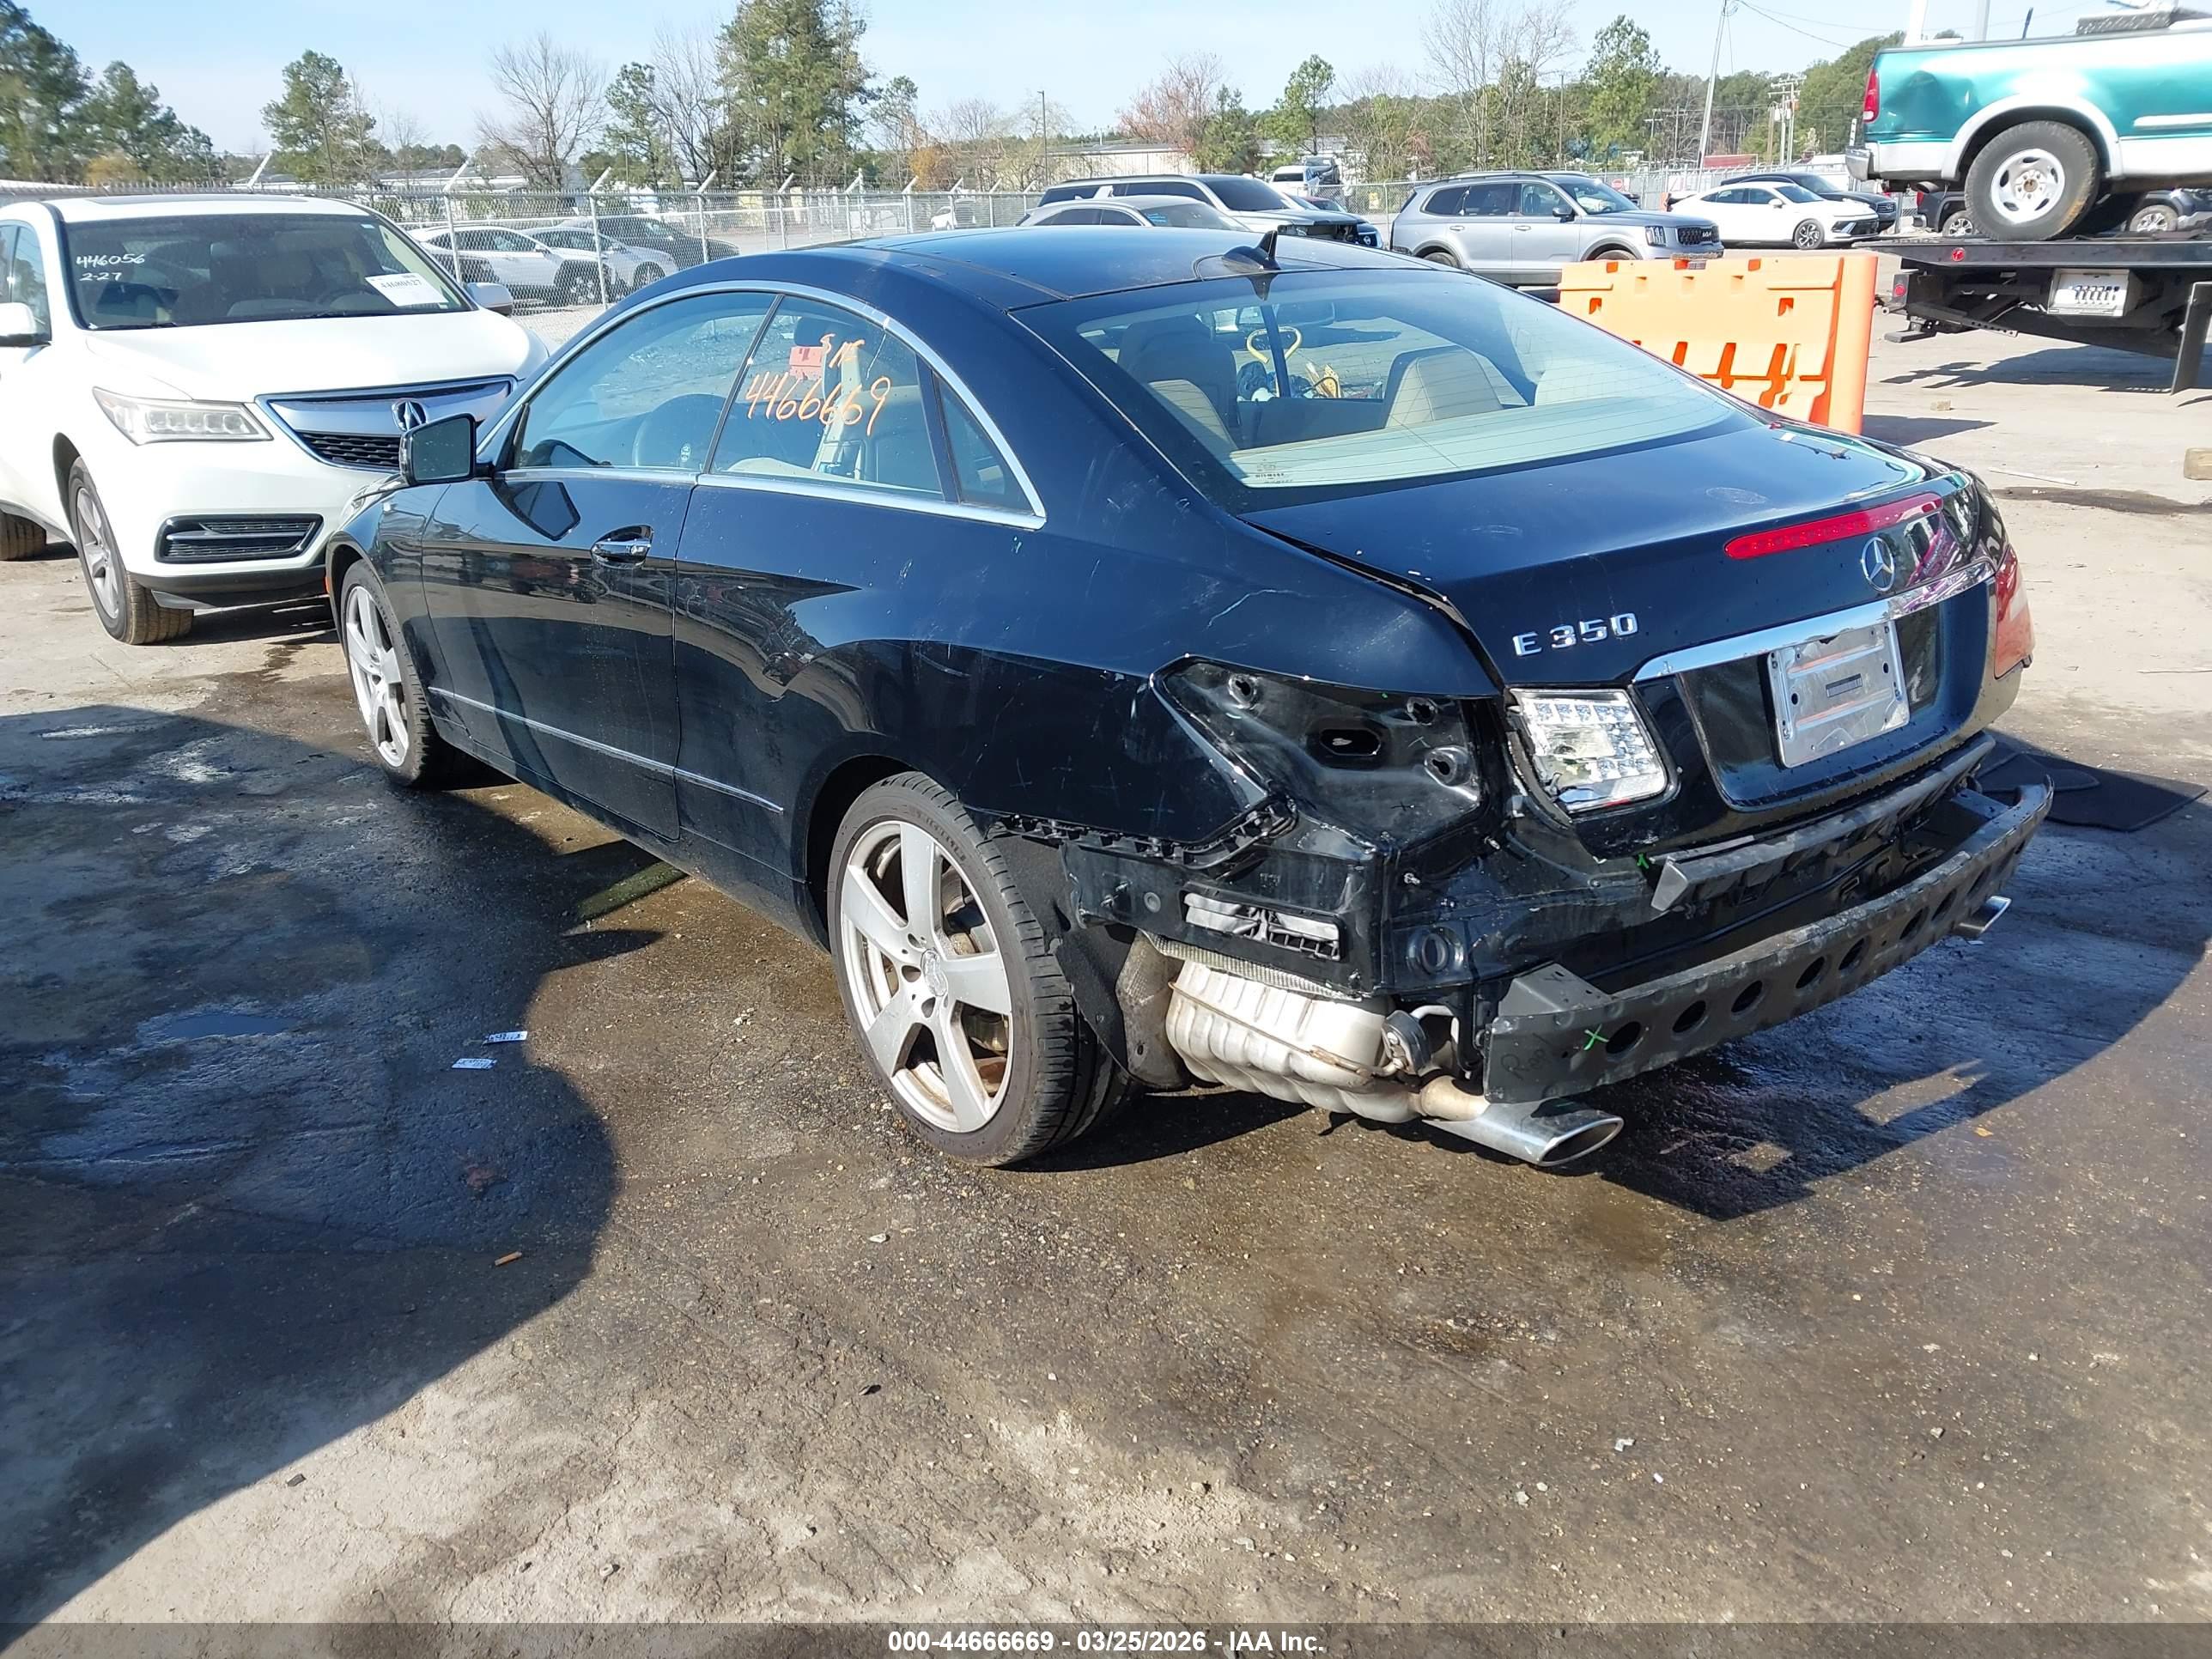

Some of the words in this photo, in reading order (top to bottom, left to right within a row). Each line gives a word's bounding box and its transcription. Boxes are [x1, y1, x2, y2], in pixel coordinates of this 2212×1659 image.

[76, 253, 145, 268] 446056
[79, 272, 122, 281] 2-27
[744, 370, 892, 437] 4466669
[1512, 630, 1543, 657] E
[1549, 612, 1638, 649] 350
